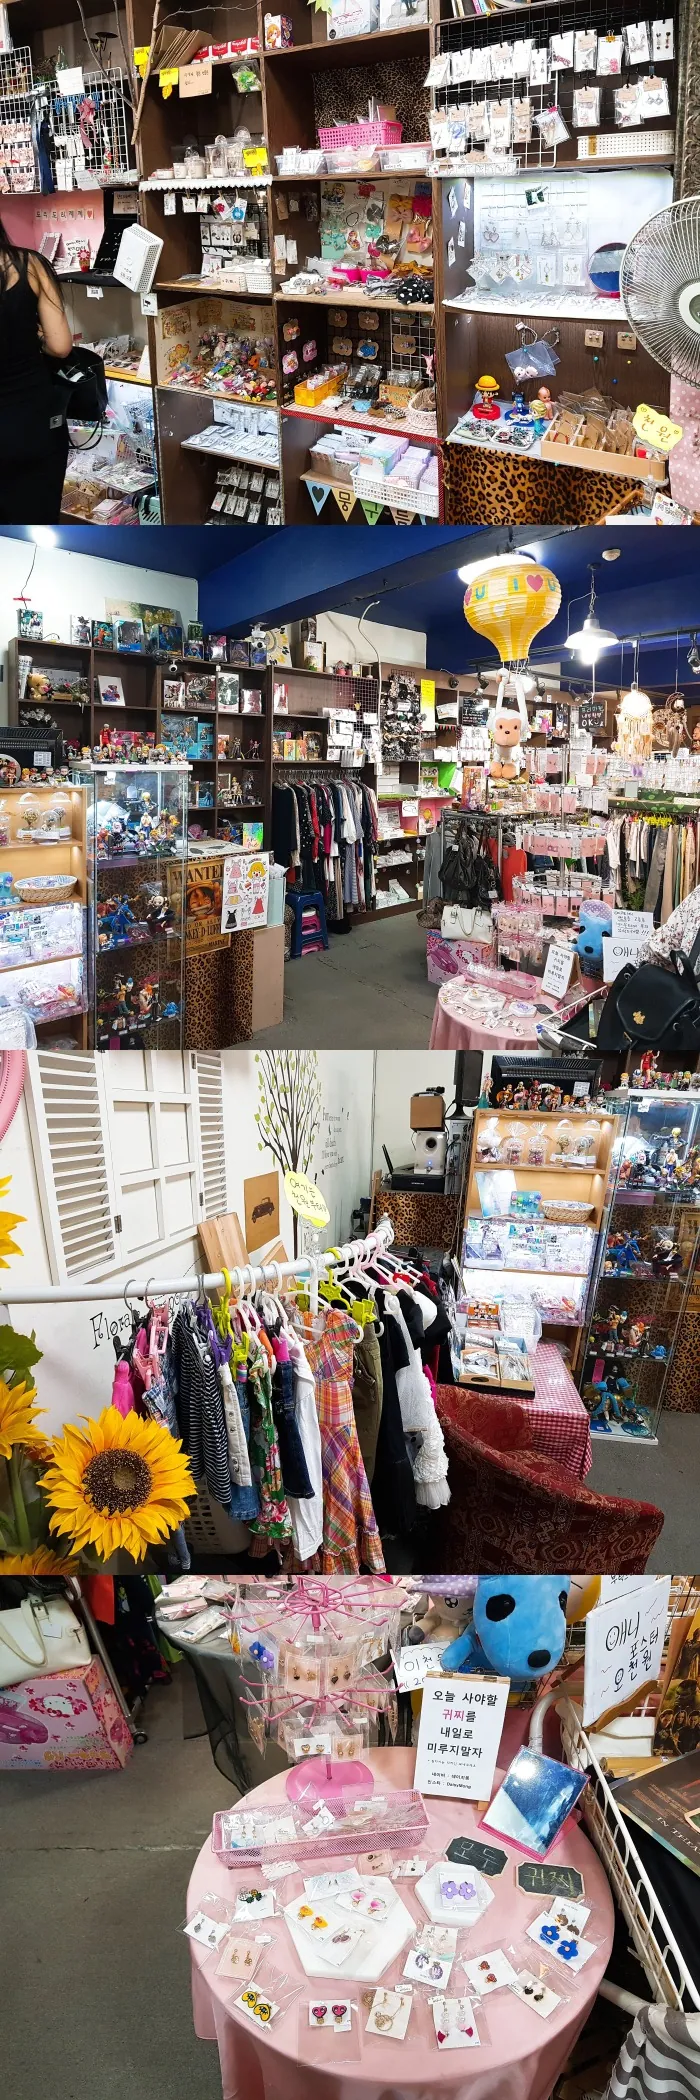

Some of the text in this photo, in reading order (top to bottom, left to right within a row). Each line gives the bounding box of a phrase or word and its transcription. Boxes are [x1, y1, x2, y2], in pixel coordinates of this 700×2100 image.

[605, 1611, 640, 1651] 애니
[630, 1626, 659, 1660] 포스터
[432, 1690, 498, 1707] 오늘 사야할
[442, 1708, 476, 1722] 귀찌를
[440, 1726, 473, 1739] 내일로
[427, 1742, 483, 1758] 미루지말자
[453, 1841, 499, 1869] 모두
